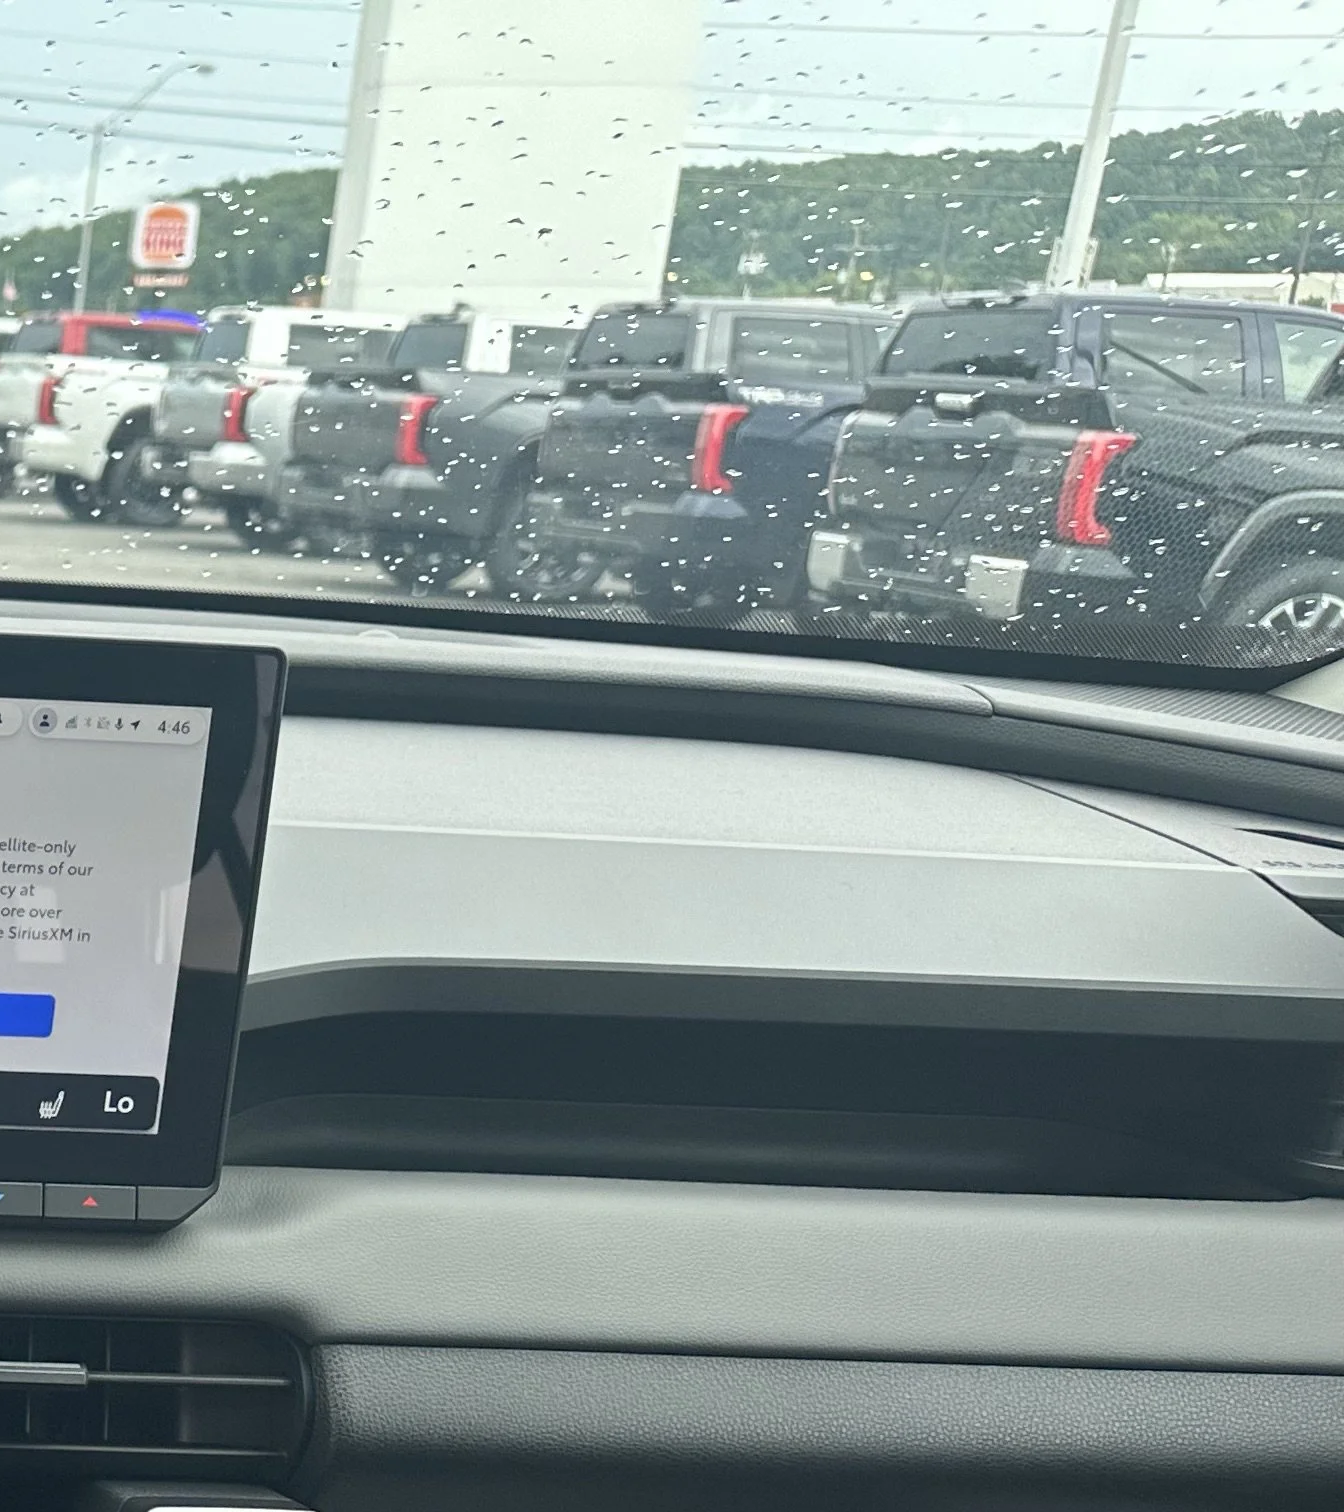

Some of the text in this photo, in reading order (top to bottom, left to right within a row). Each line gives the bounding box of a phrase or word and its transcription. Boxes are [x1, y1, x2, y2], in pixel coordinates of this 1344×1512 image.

[157, 720, 191, 735] 4:46
[2, 861, 44, 875] terms
[48, 861, 64, 875] of
[67, 864, 93, 876] our
[20, 884, 35, 897] at
[29, 907, 62, 919] over
[103, 1090, 134, 1114] Lo
